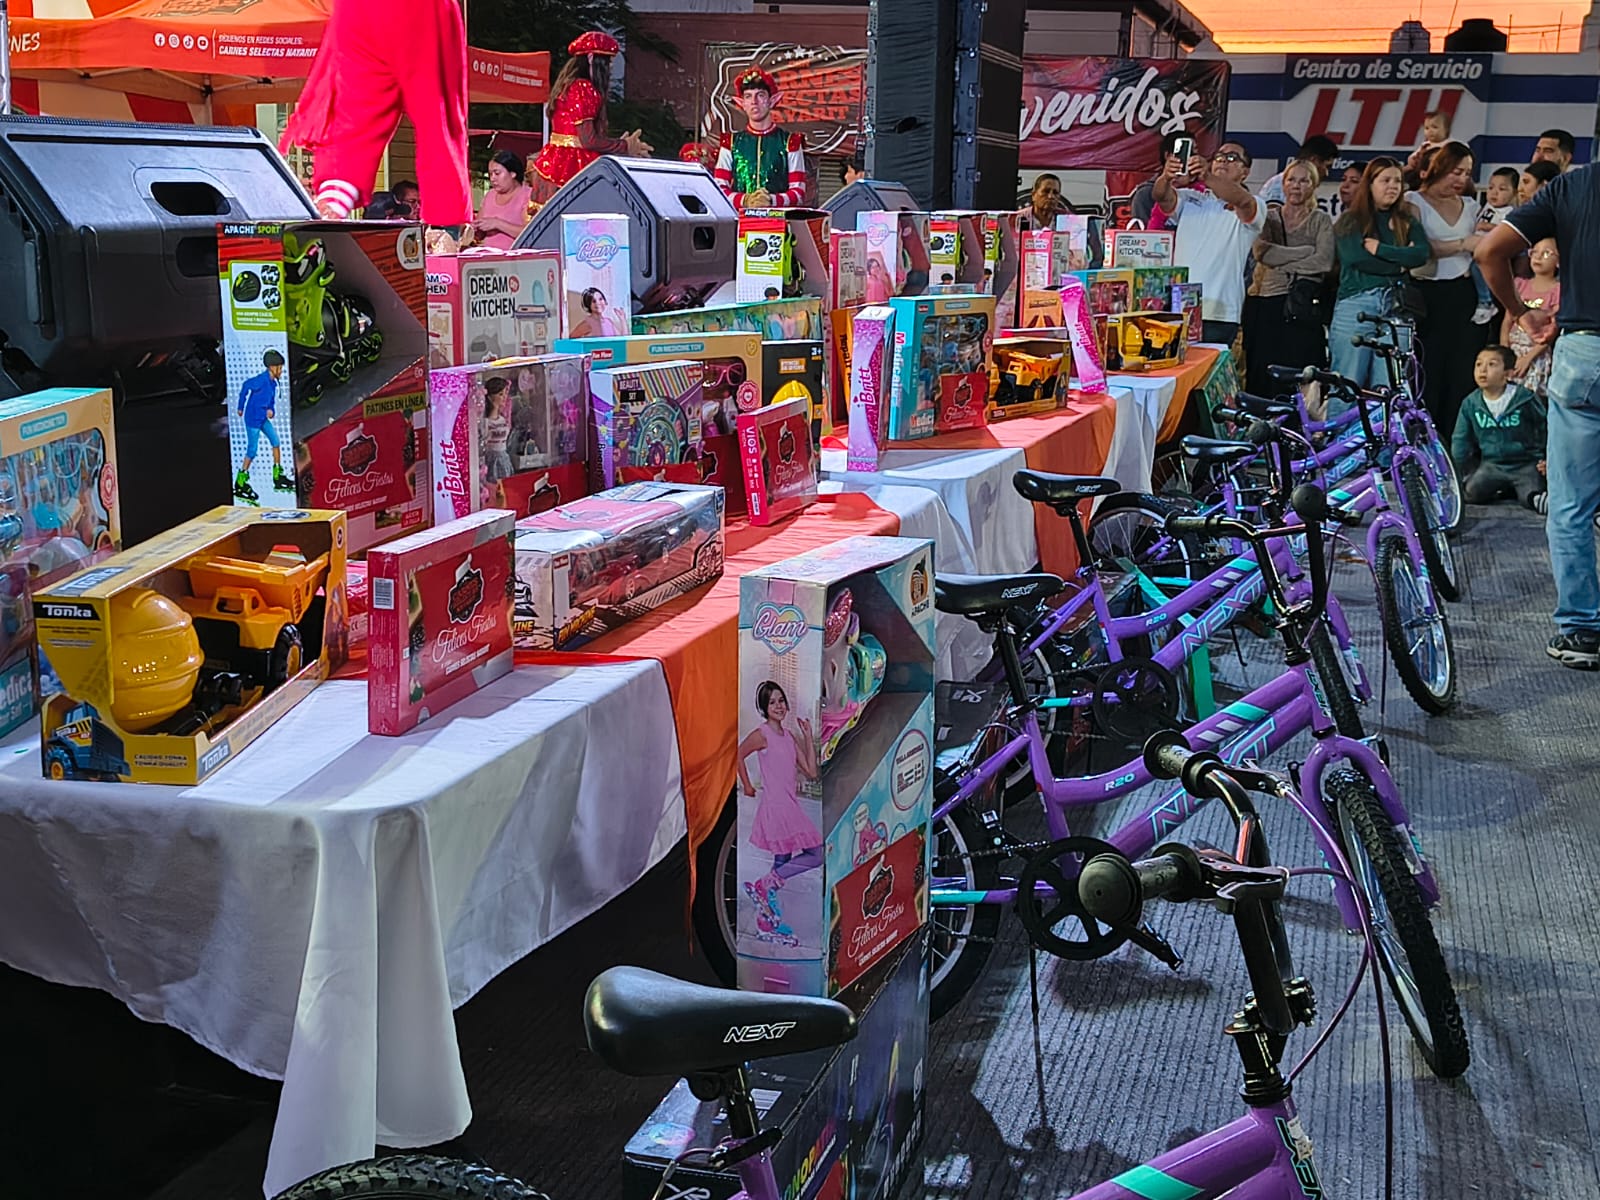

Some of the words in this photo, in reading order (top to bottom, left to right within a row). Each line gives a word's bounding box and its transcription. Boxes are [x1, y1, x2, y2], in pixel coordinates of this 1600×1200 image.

[219, 45, 247, 56] CARNES
[249, 47, 285, 57] SELECTAS
[286, 48, 318, 58] NAYARIT
[1294, 58, 1360, 79] Centro
[1365, 59, 1391, 79] de
[1397, 58, 1483, 80] Servicio
[1304, 88, 1465, 147] LTH
[223, 225, 254, 235] APACHE
[257, 225, 281, 235] SPORT
[1119, 239, 1140, 247] DREAM
[470, 275, 508, 296] DREAM
[471, 297, 516, 318] KITCHEN
[619, 379, 640, 390] BEAUTY
[858, 366, 876, 406] Britt
[1475, 410, 1520, 428] VANS
[440, 438, 465, 496] Britt
[324, 478, 361, 504] Felices
[362, 471, 393, 492] Fiestas
[42, 604, 92, 617] Tonka
[911, 599, 930, 618] APACHE
[1180, 568, 1267, 657] NEXT
[753, 611, 807, 639] Glam
[433, 627, 468, 662] Felices
[468, 614, 497, 641] Fiestas
[202, 742, 230, 772] Tonka
[1105, 773, 1136, 792] R20
[847, 922, 878, 958] Felices
[723, 1022, 797, 1044] NEXT
